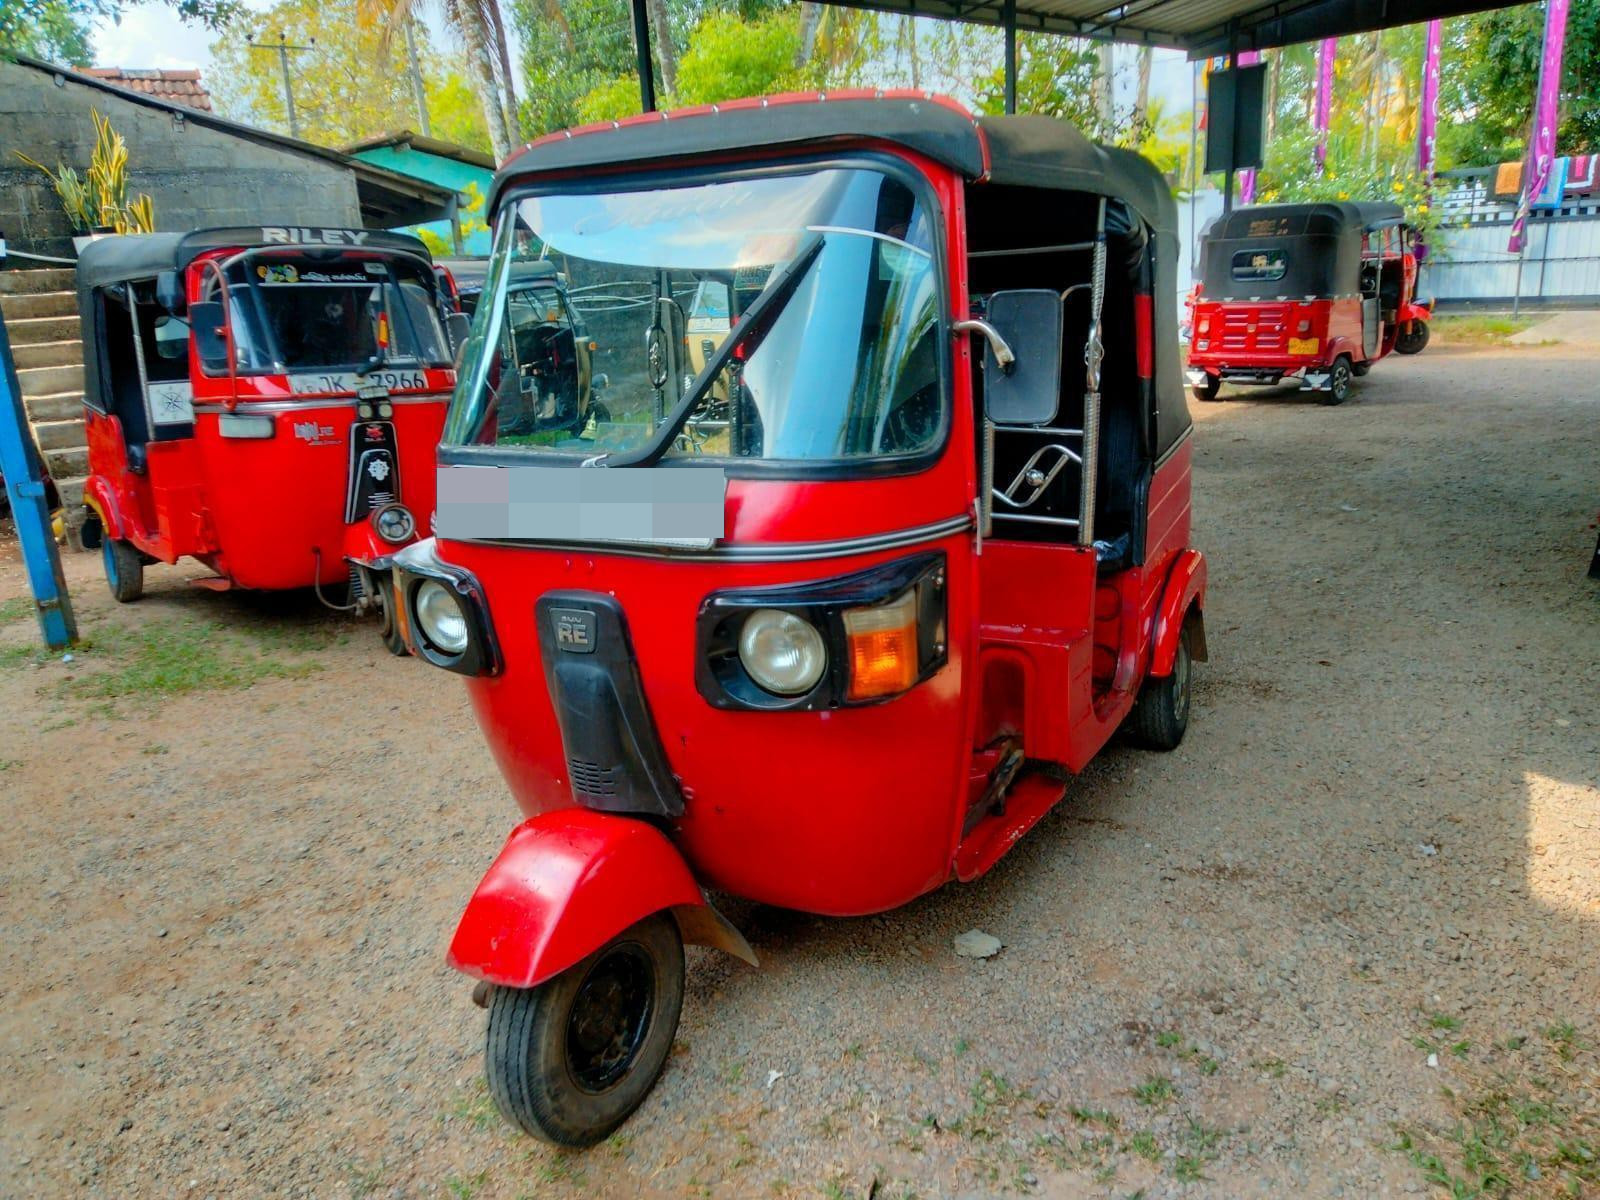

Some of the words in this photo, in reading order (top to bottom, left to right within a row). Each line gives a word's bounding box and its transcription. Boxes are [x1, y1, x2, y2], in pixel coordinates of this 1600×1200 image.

[261, 227, 369, 245] RILEY
[369, 373, 425, 390] 7966
[558, 622, 588, 644] RE
